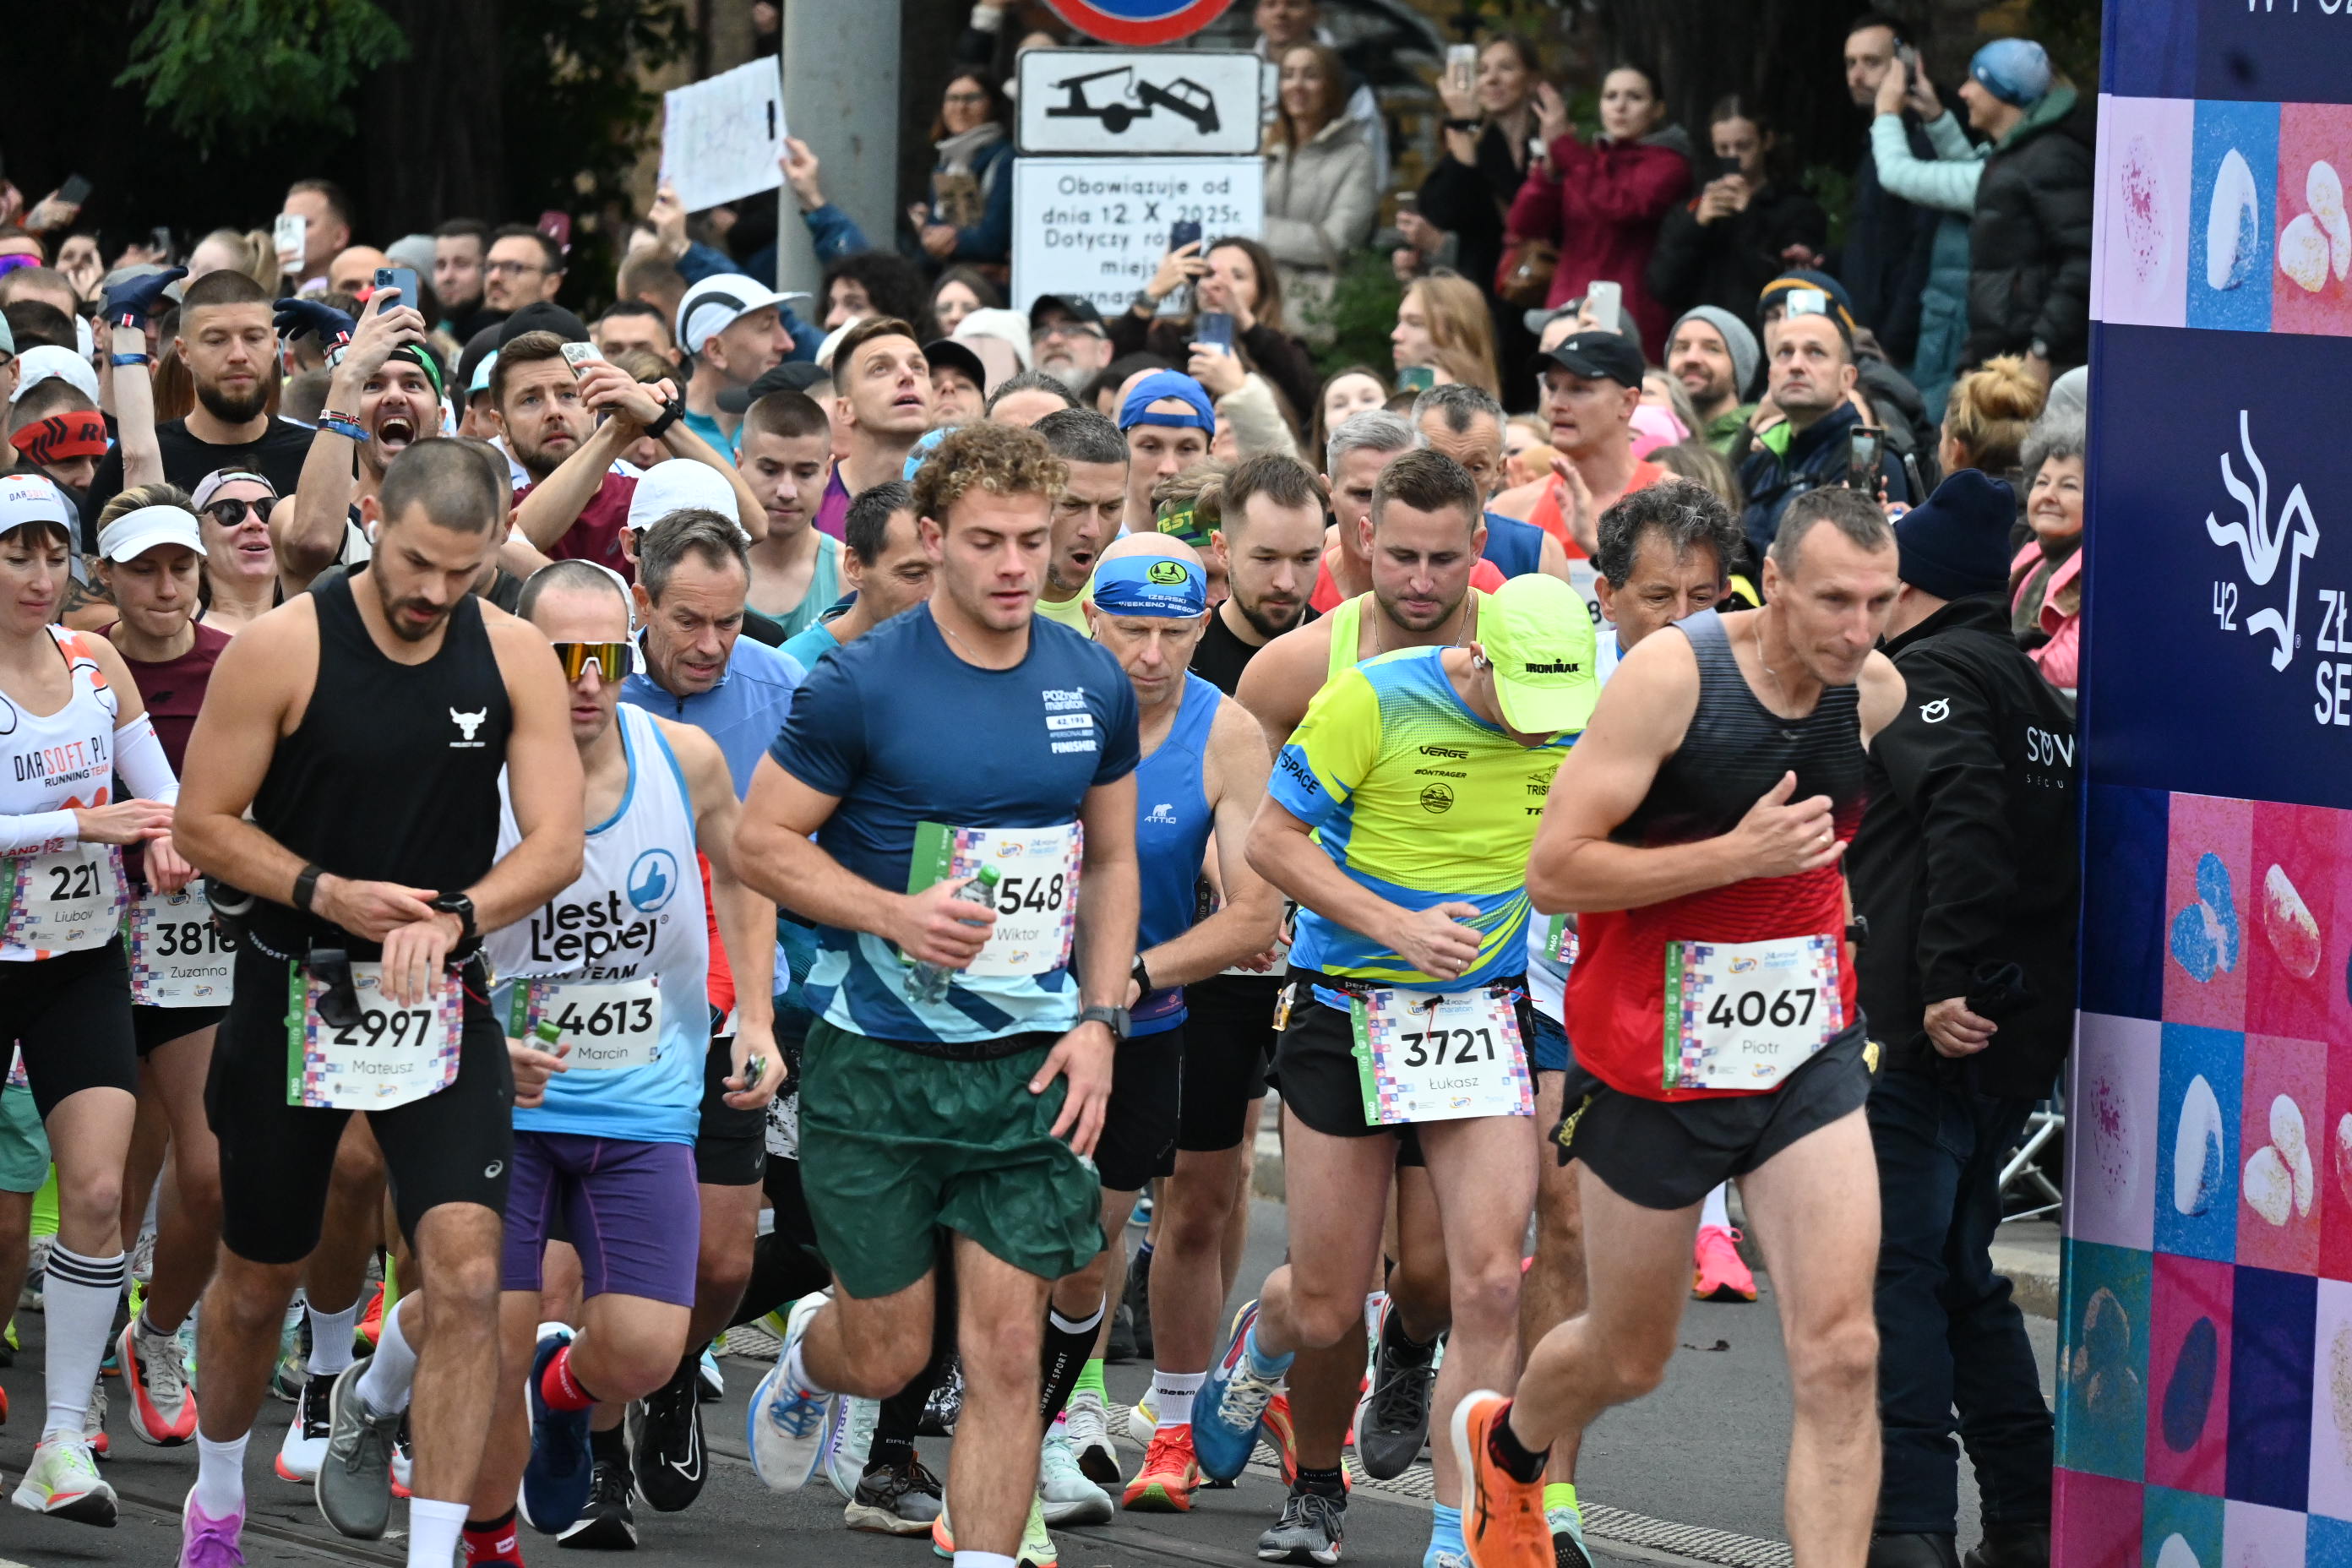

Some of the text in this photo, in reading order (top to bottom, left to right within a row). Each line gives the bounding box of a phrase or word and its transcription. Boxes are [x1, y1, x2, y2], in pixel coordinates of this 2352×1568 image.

[1058, 176, 1232, 199] Obowiązuje od
[1043, 206, 1091, 225] dnia
[1144, 202, 1160, 222] X
[1045, 229, 1131, 251] Dotyczy
[1148, 594, 1187, 604] IZERSKI
[2213, 581, 2238, 631] 42
[2317, 590, 2352, 654] ZŁ
[1526, 658, 1580, 673] IRONMAN
[2314, 660, 2352, 727] SE
[1051, 740, 1097, 754] FINISHER
[1419, 746, 1469, 760] VERGE
[45, 763, 109, 787] RUNNING TEAM
[1414, 769, 1467, 779] BONTRAGER
[1144, 815, 1176, 825] ATTIQ
[49, 861, 101, 901] 221
[994, 873, 1064, 915] 548
[55, 910, 95, 923] Liubov
[543, 890, 623, 940] Jest
[997, 928, 1040, 941] Wiktor
[1549, 934, 1558, 951] M60
[171, 966, 227, 979] Zuzanna
[556, 997, 653, 1036] 4613
[1707, 988, 1816, 1028] 4067
[579, 1047, 629, 1060] Marcin
[1401, 1027, 1494, 1067] 3721
[1742, 1039, 1780, 1054] Piotr
[352, 1060, 414, 1074] Mateusz
[1429, 1076, 1479, 1090] Łukasz
